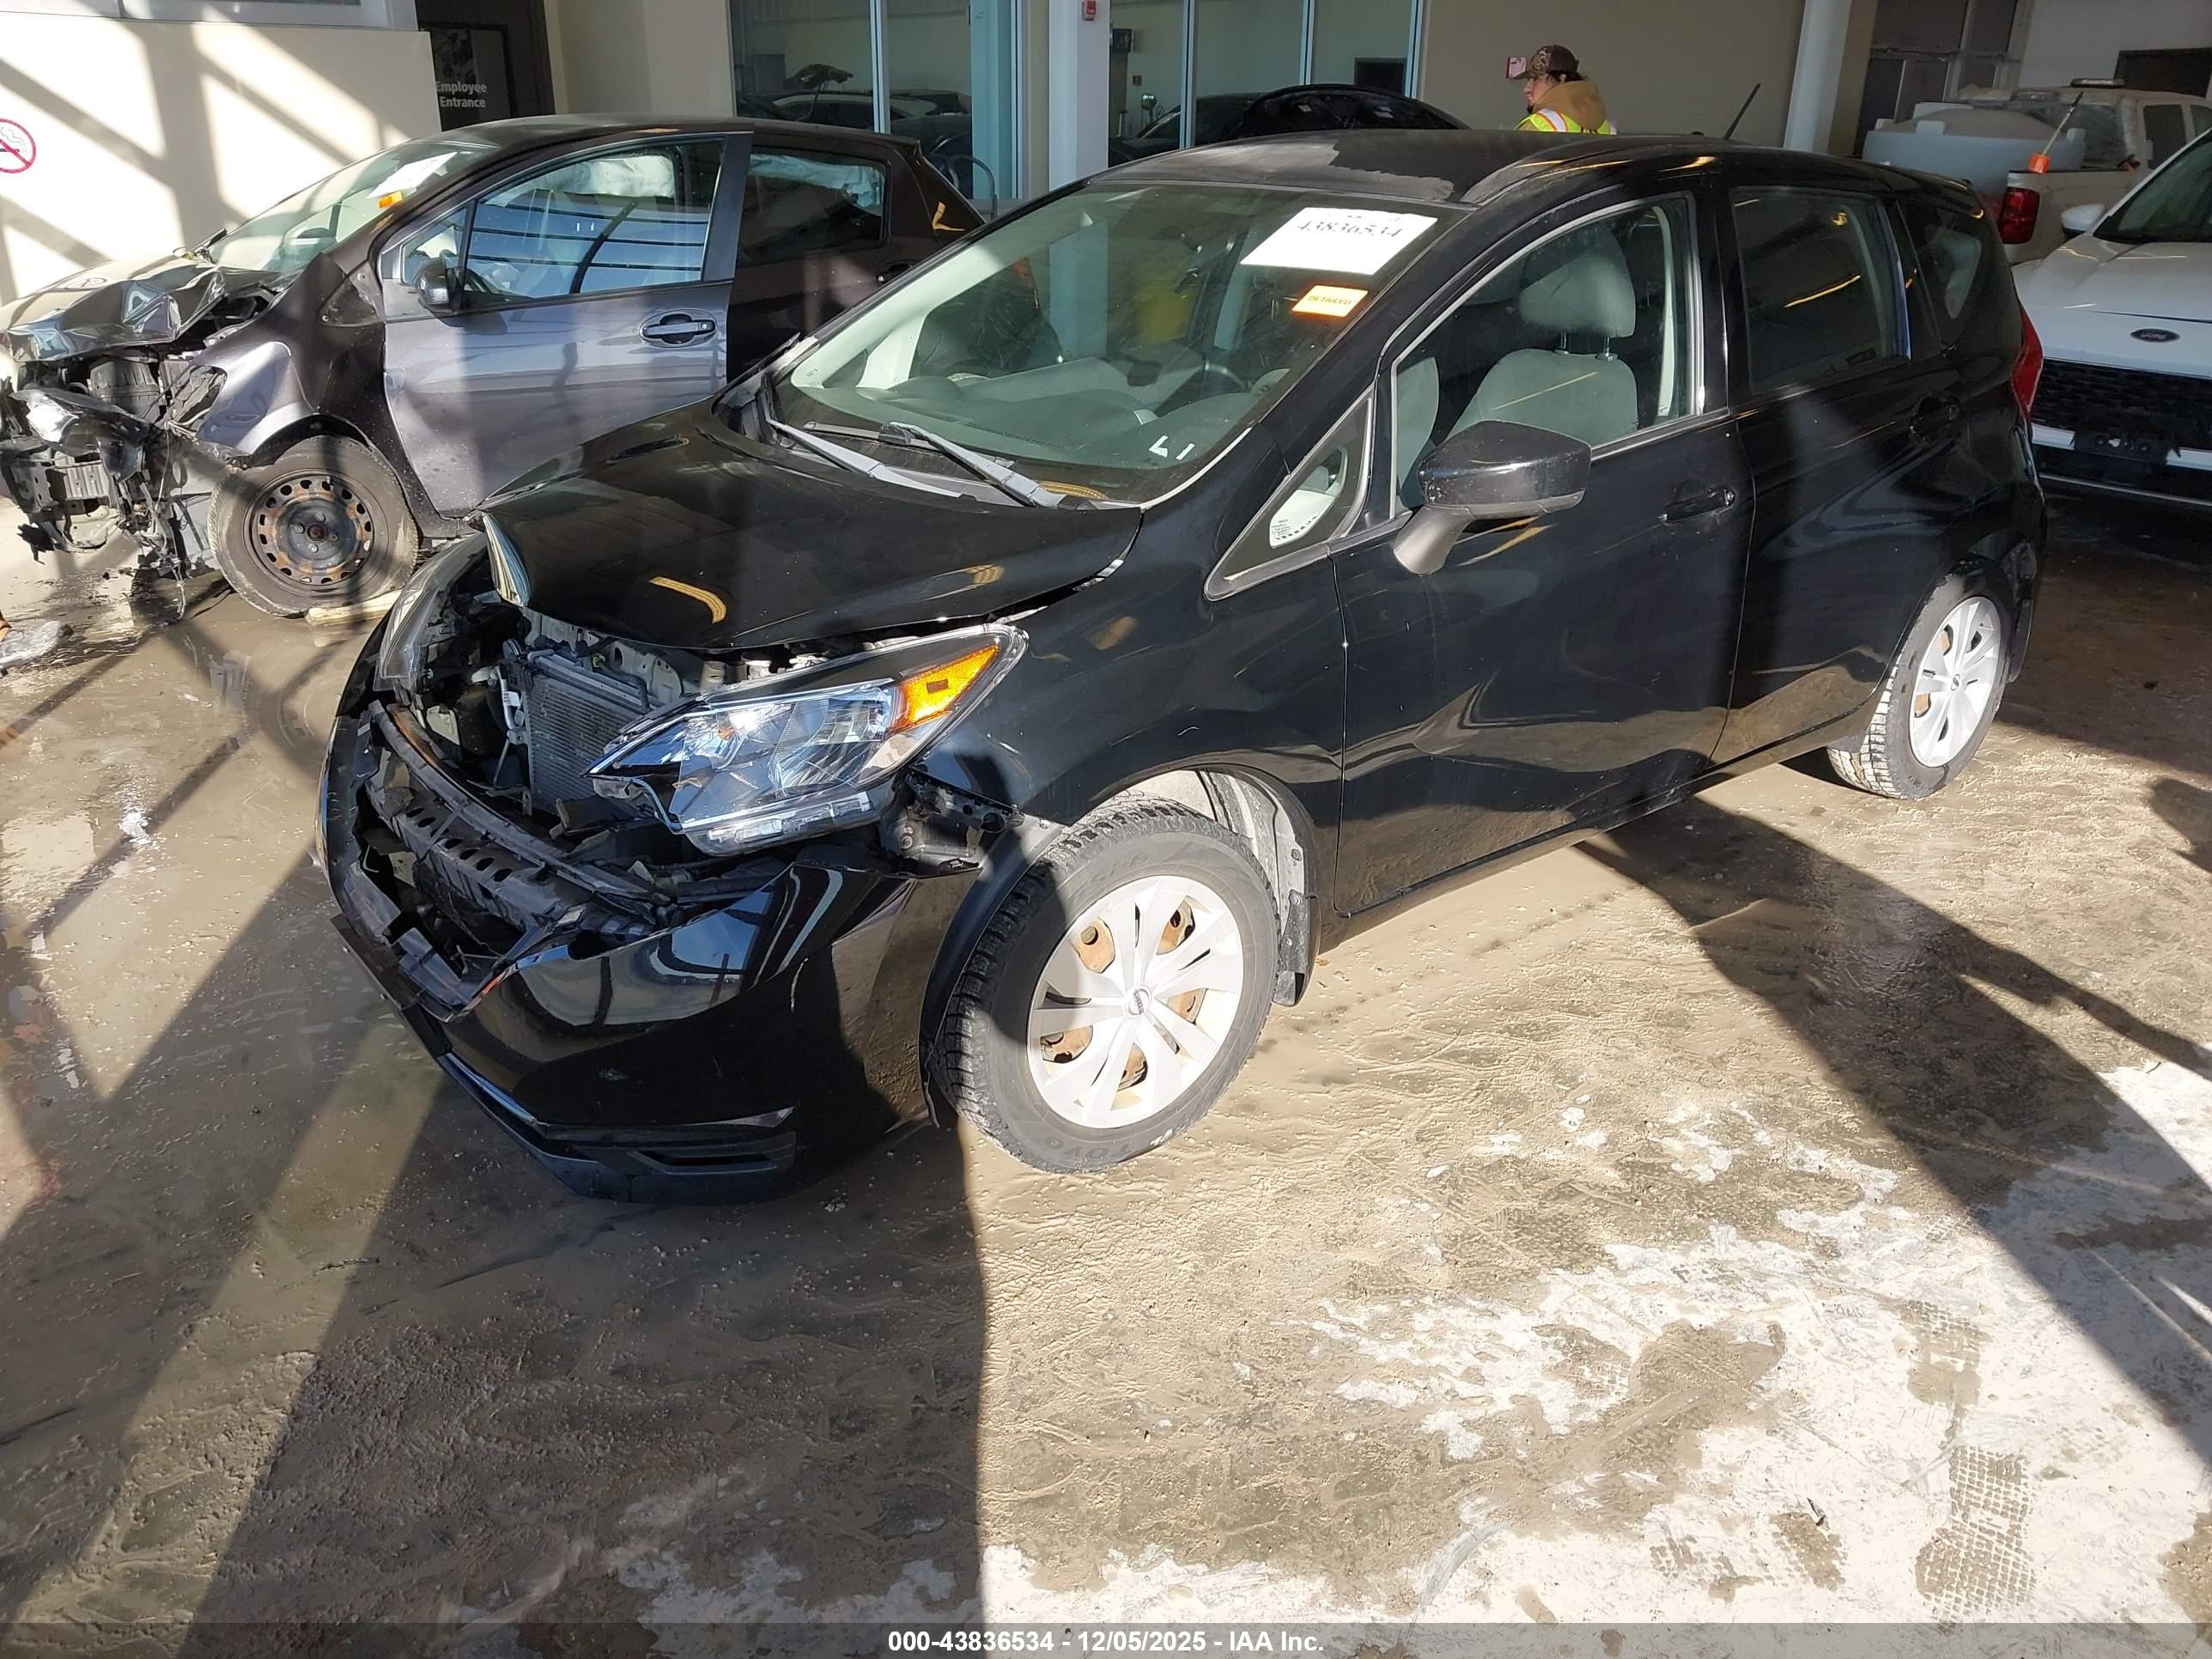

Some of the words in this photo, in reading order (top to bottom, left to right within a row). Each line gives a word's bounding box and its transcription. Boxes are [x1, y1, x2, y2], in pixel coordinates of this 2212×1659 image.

[436, 81, 488, 94] Employee
[440, 96, 486, 108] Entrance
[1308, 295, 1352, 305] DETAILED
